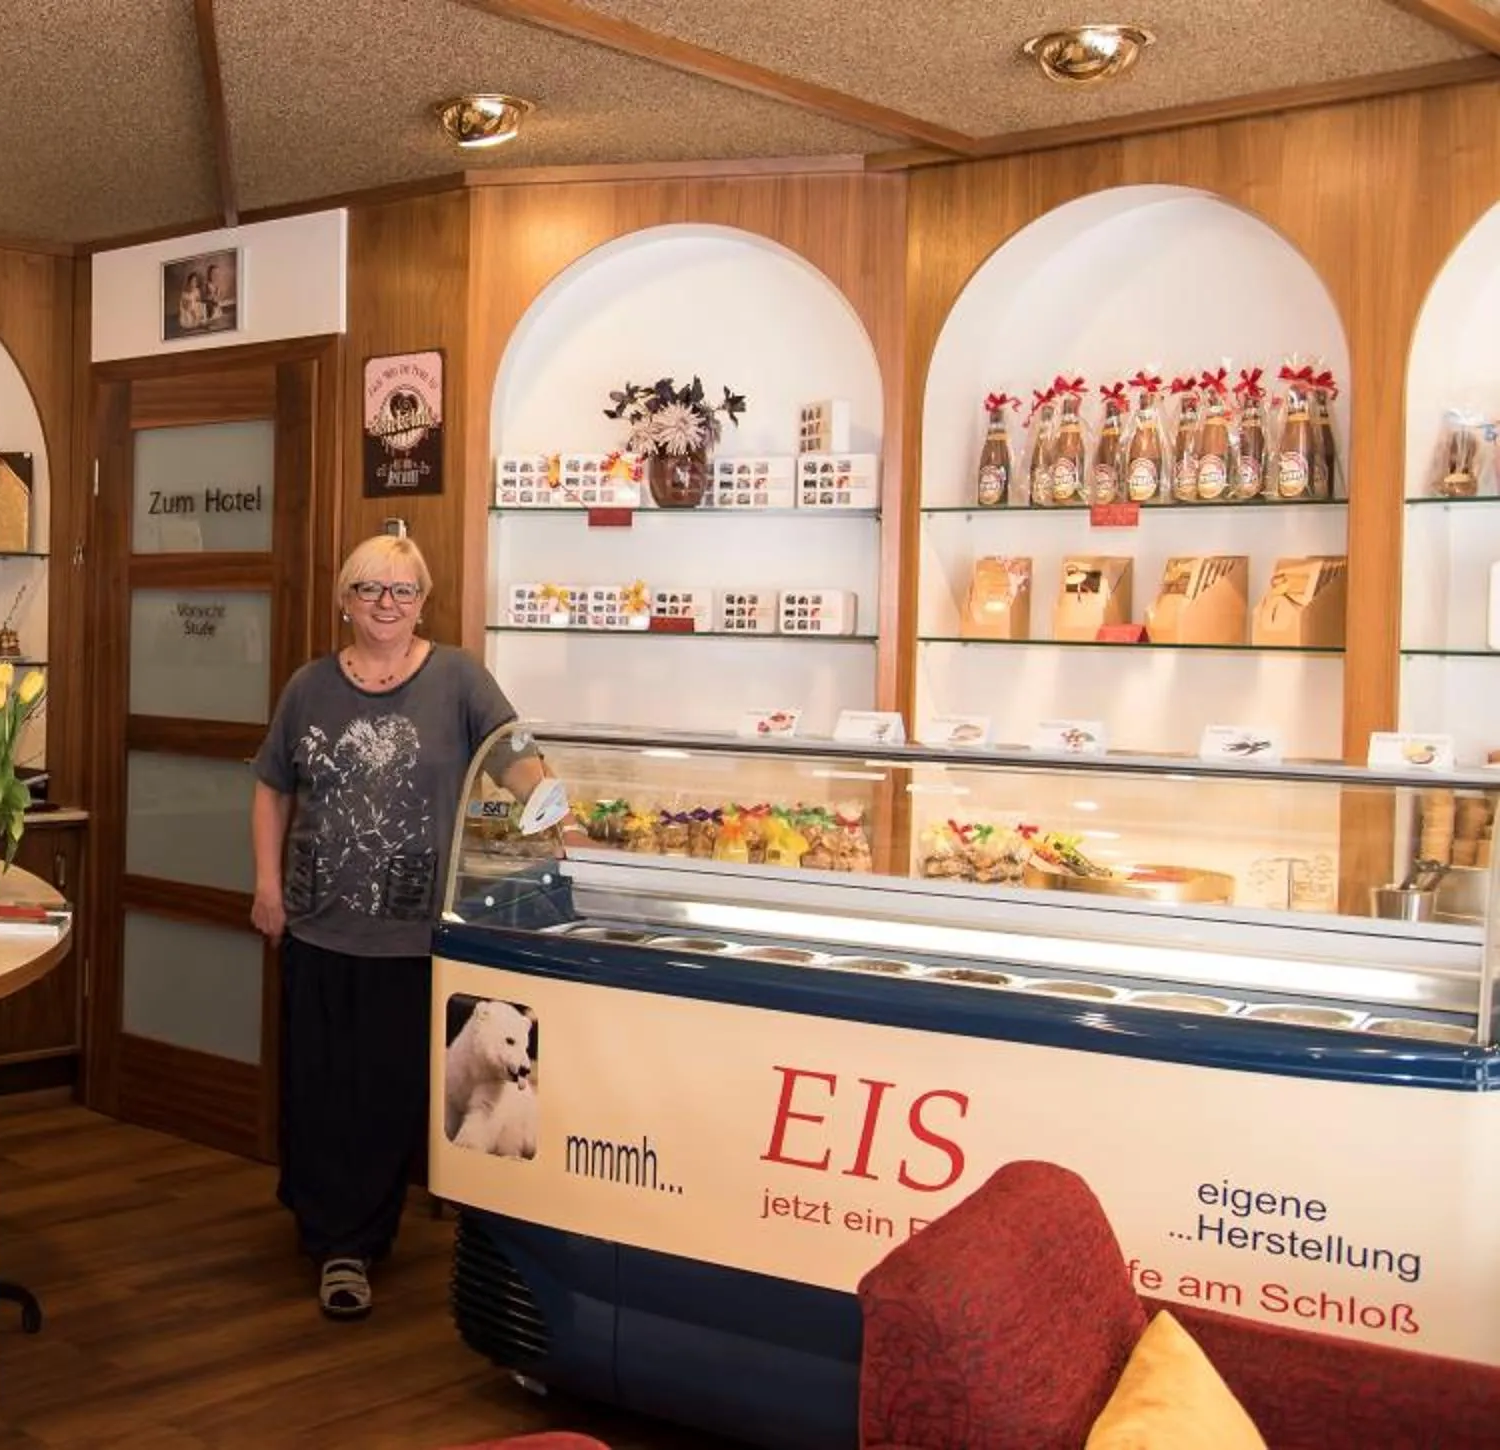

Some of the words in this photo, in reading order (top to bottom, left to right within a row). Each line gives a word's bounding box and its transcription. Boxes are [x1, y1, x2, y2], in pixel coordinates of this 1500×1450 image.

[148, 491, 195, 515] Zum
[204, 484, 262, 513] Hotel
[760, 1065, 970, 1193] EIS
[565, 1134, 684, 1195] mmmh...
[1197, 1178, 1328, 1222] eigene
[760, 1188, 832, 1226] jetzt
[843, 1208, 894, 1238] ein
[1124, 1259, 1163, 1291] fe
[1177, 1274, 1243, 1307] am
[1260, 1282, 1421, 1335] Schloß
